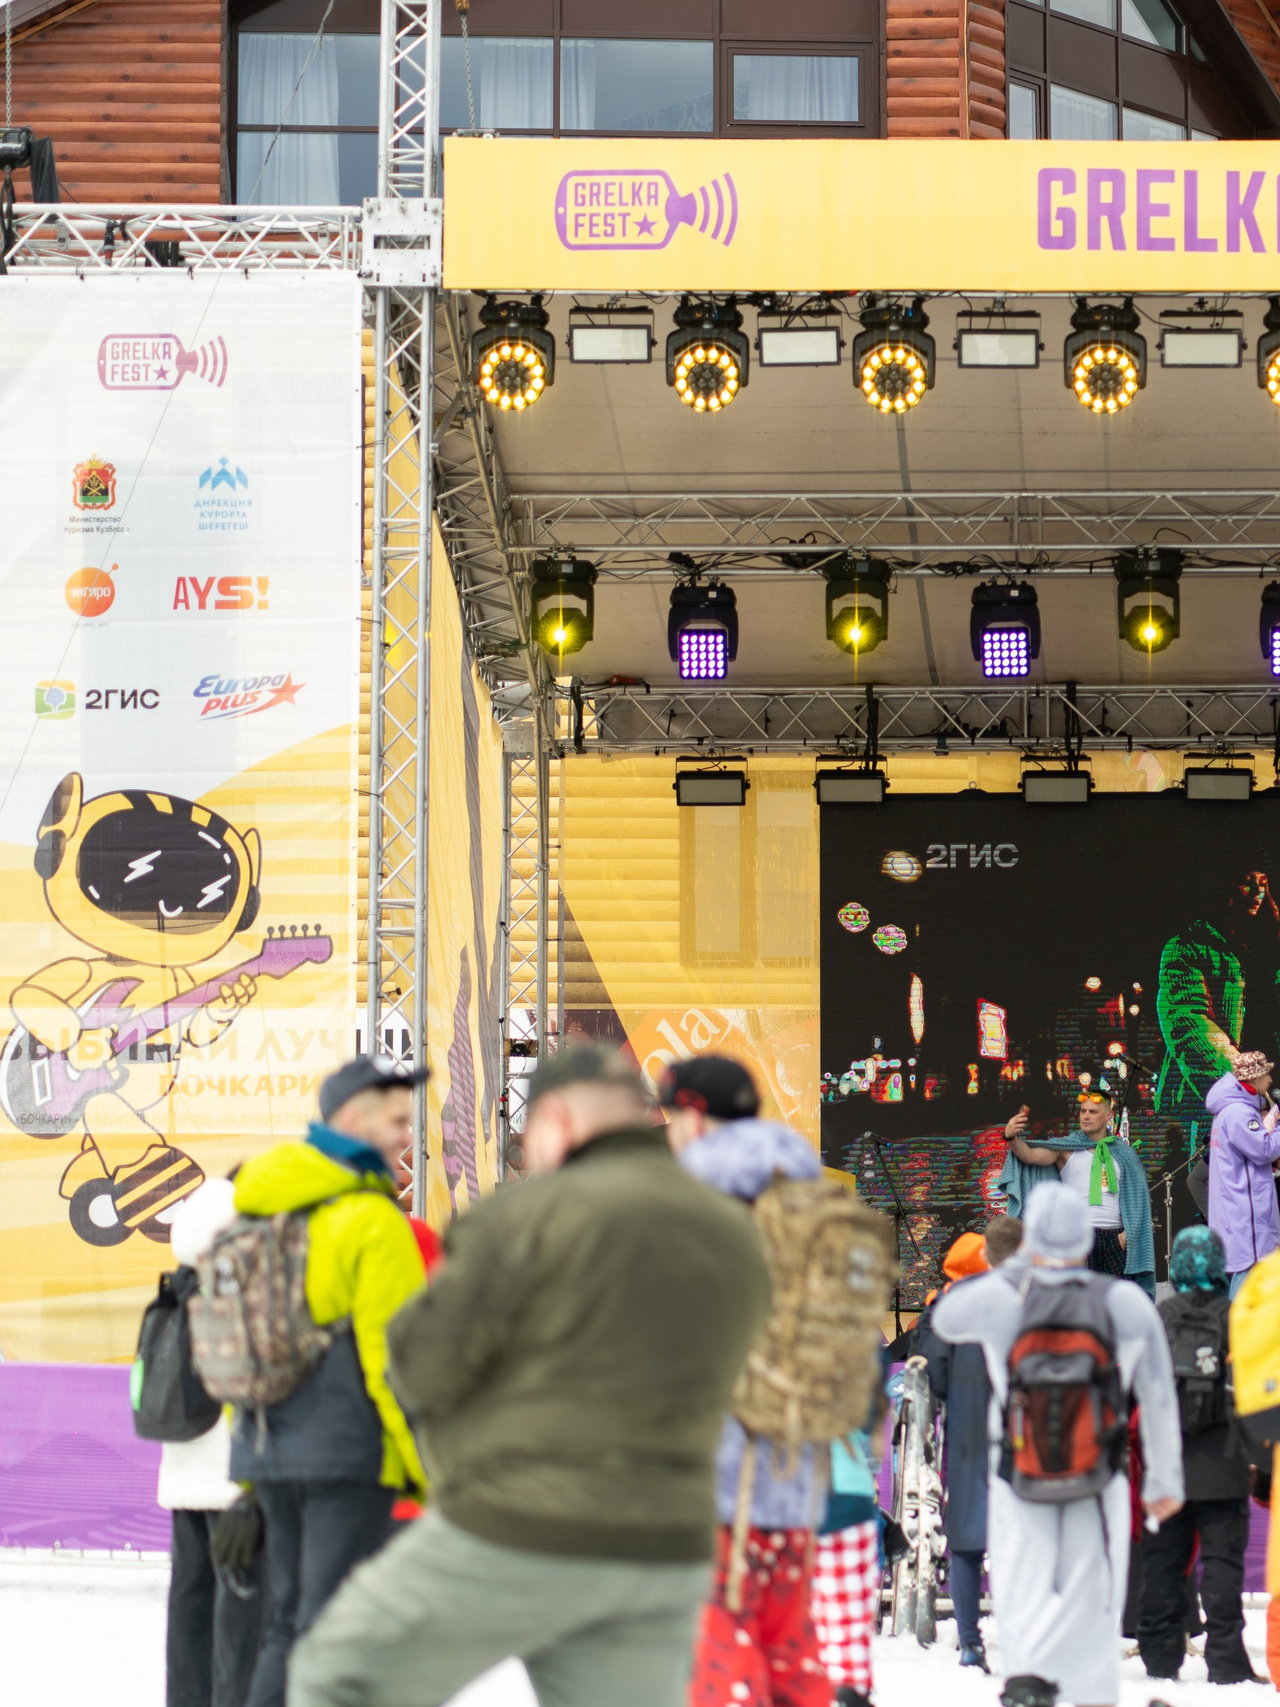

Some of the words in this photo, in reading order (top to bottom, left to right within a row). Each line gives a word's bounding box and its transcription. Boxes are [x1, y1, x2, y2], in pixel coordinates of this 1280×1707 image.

[573, 181, 660, 207] GRELKA
[573, 212, 632, 238] FEST
[110, 341, 172, 360] GRELKA
[110, 363, 152, 382] FEST
[194, 499, 253, 509] ДИРЕКЦИЯ
[69, 516, 122, 524] Министерство
[199, 511, 248, 519] КУРОРТА
[64, 527, 95, 535] туризма
[198, 522, 249, 531] ШЕРЕГЕШ
[172, 576, 270, 611] AYS!
[85, 689, 161, 711] 2ГИС
[926, 843, 1020, 869] 2ГИС
